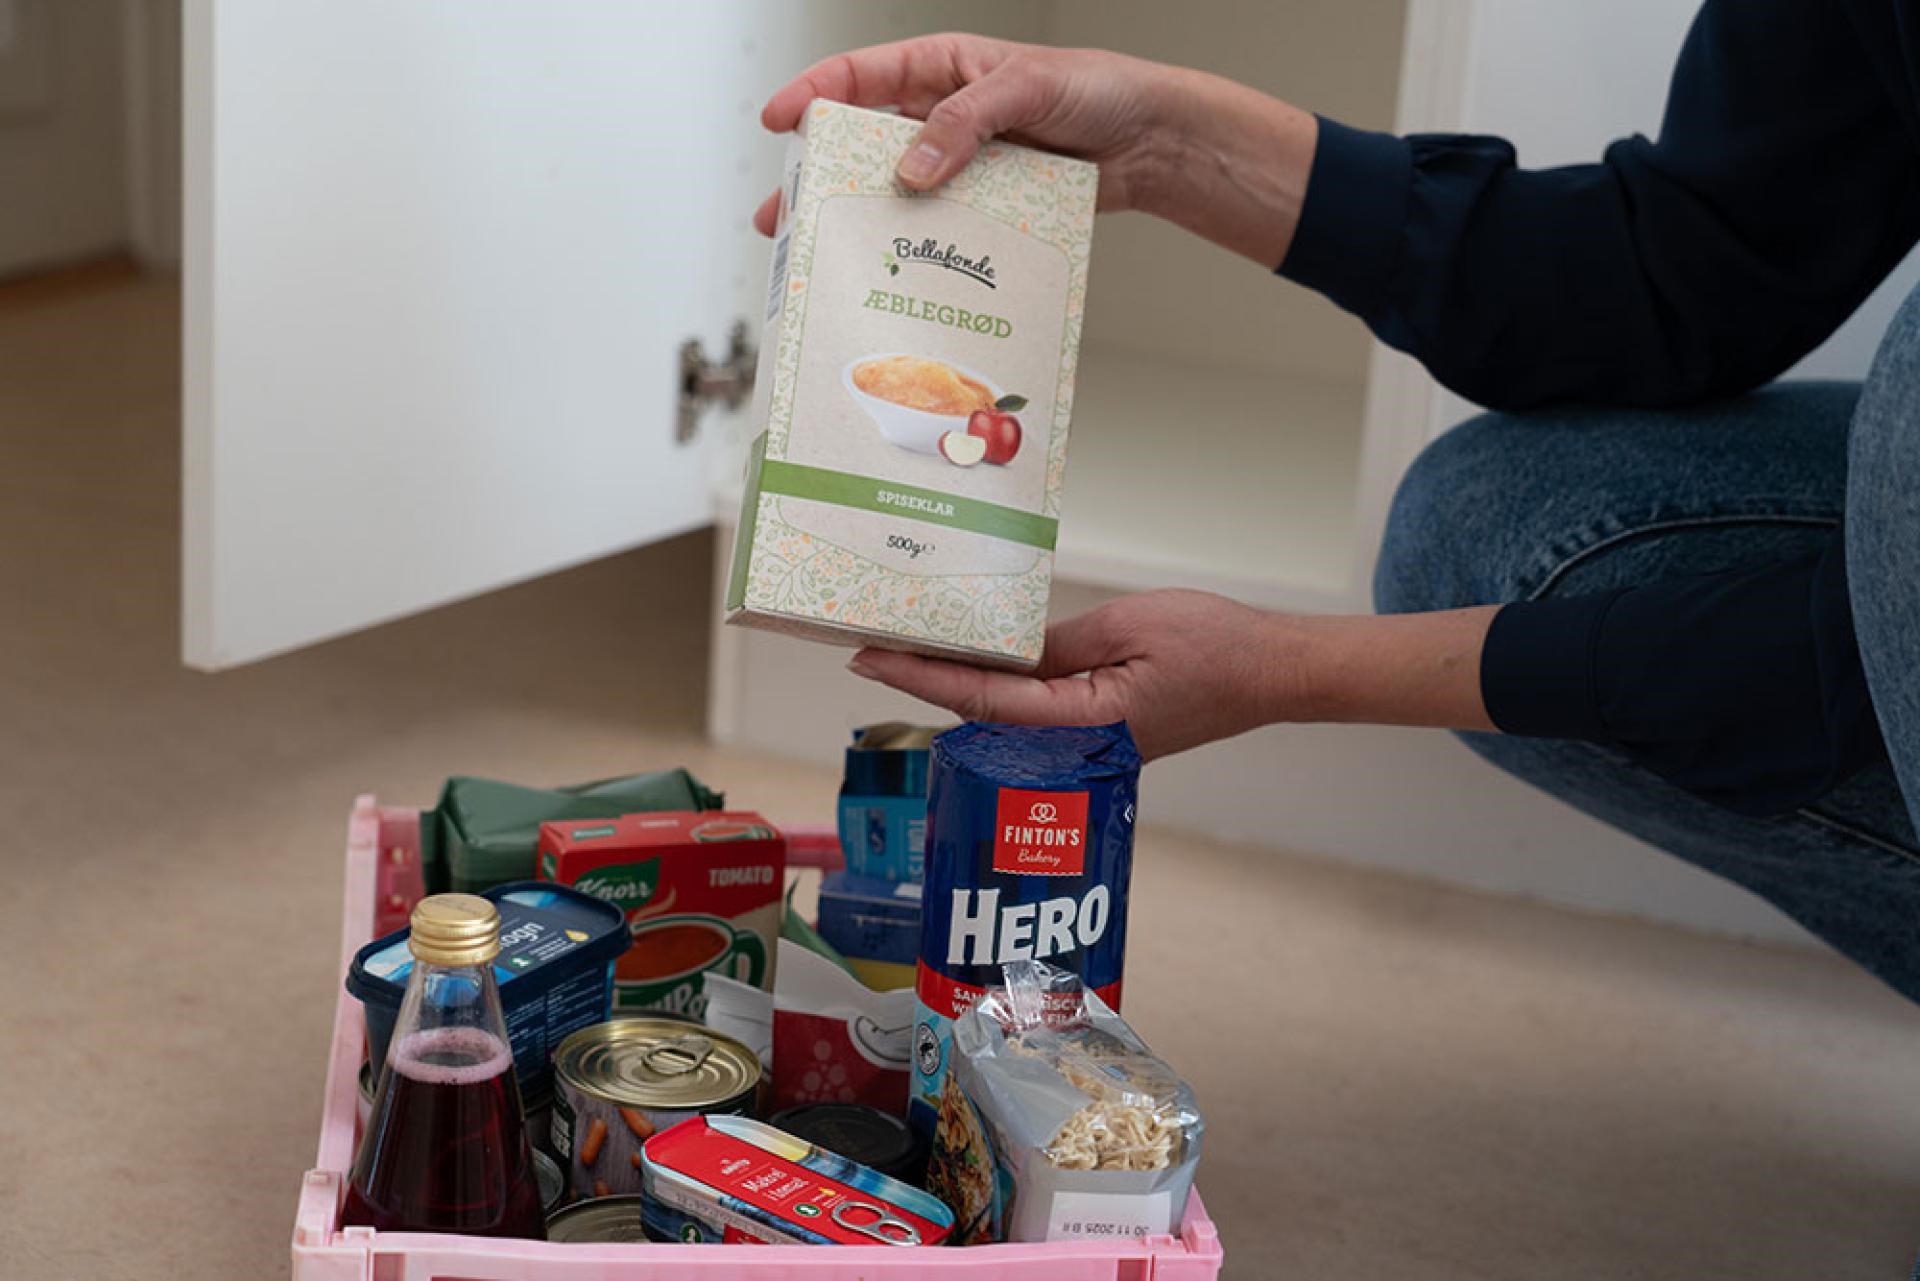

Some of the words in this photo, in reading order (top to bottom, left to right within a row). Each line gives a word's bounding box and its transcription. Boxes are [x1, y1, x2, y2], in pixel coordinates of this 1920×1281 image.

[892, 237, 996, 280] Bellafonde
[862, 289, 1013, 339] ÆBLEGRØD
[877, 489, 955, 517] SPISEKLAR
[1004, 825, 1080, 846] FINTON'S
[1017, 848, 1060, 867] Bakery
[709, 865, 774, 888] TOMATO
